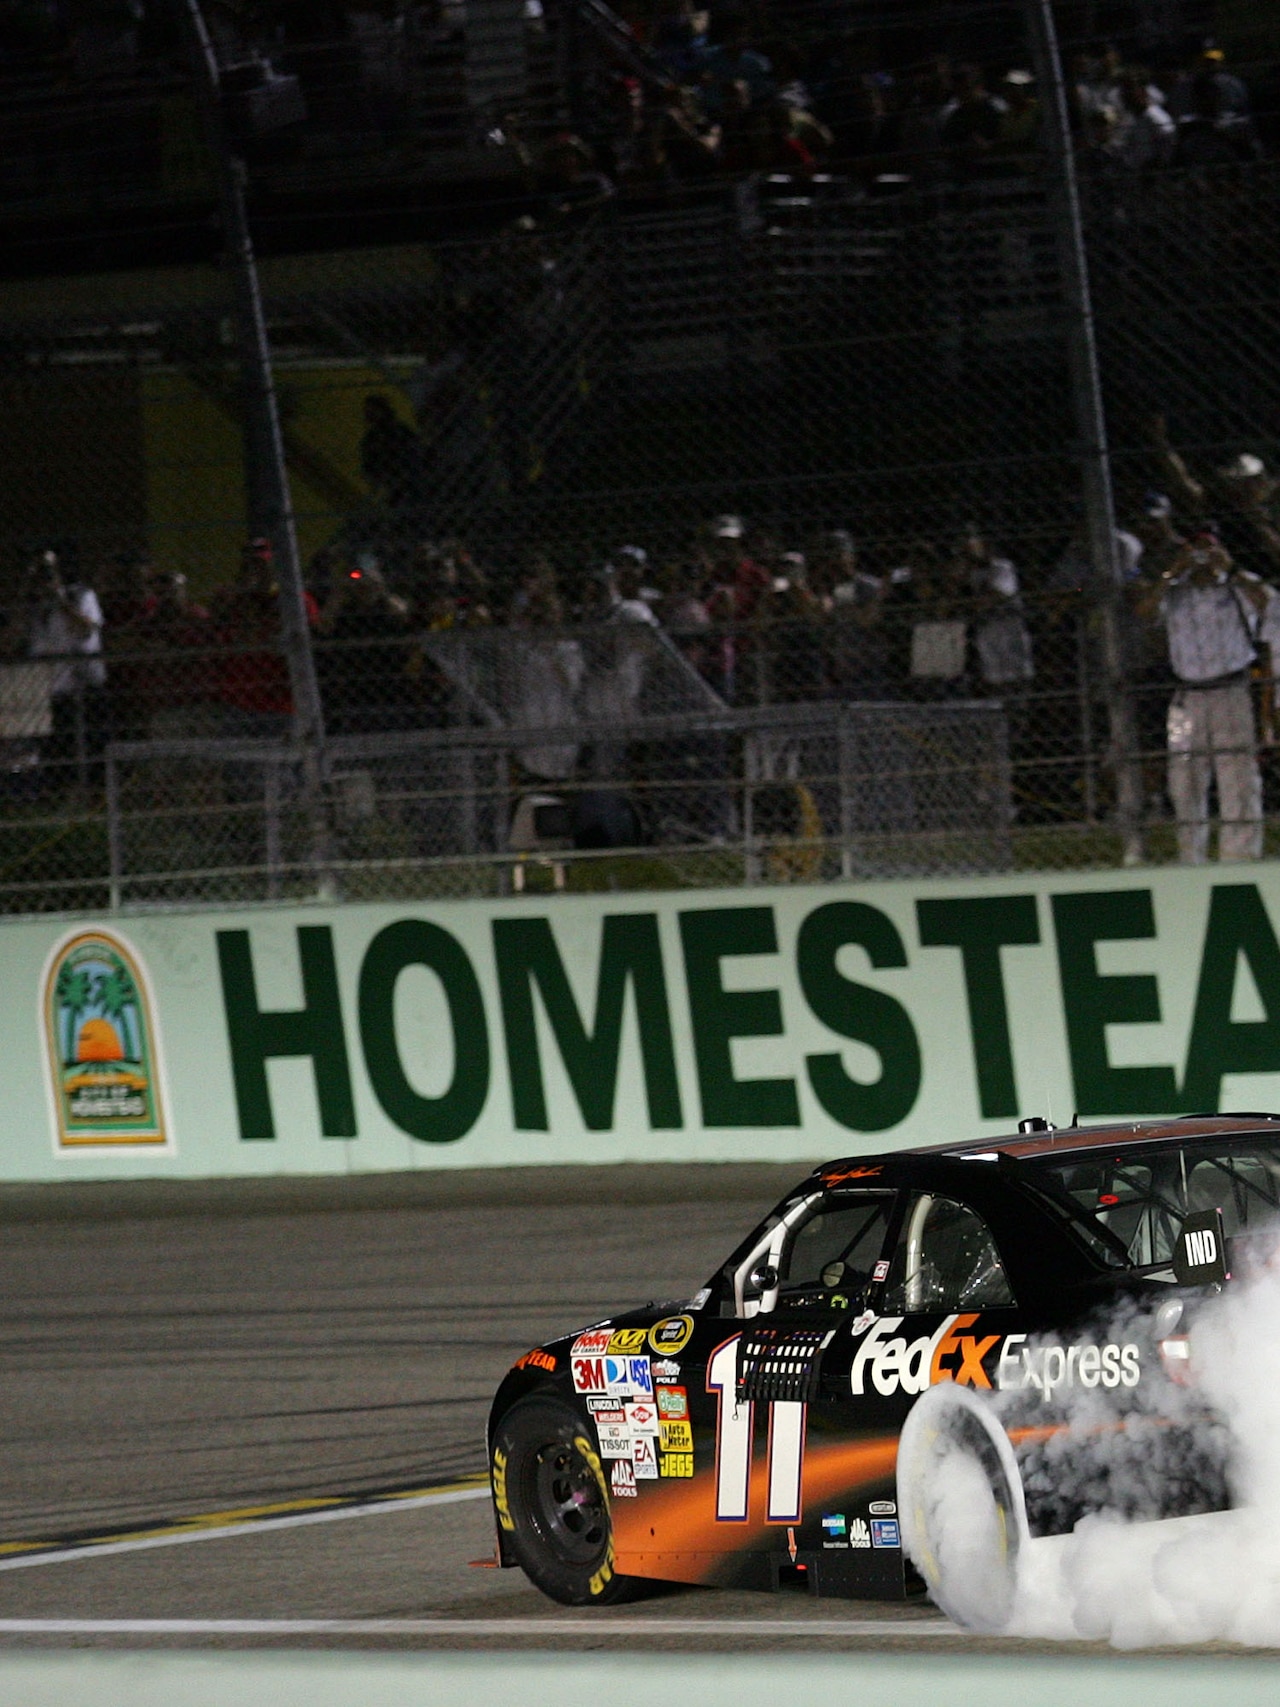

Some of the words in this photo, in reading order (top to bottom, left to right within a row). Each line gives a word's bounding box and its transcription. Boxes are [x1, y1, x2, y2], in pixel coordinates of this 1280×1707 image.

[1184, 1229, 1217, 1267] IND
[574, 1331, 608, 1351] Holley
[851, 1313, 1001, 1396] FedEx
[574, 1359, 605, 1390] 3M
[630, 1359, 651, 1392] USG
[998, 1334, 1140, 1402] Express
[589, 1400, 620, 1410] LINCOLN
[668, 1424, 685, 1433] Auto
[705, 1331, 808, 1526] 11
[600, 1439, 630, 1450] TISSOT
[634, 1440, 654, 1463] EA
[611, 1460, 636, 1486] MAC
[660, 1453, 694, 1477] JEGS
[492, 1446, 516, 1531] EAGLE
[612, 1486, 638, 1497] TOOLS
[851, 1540, 872, 1549] TOOLS
